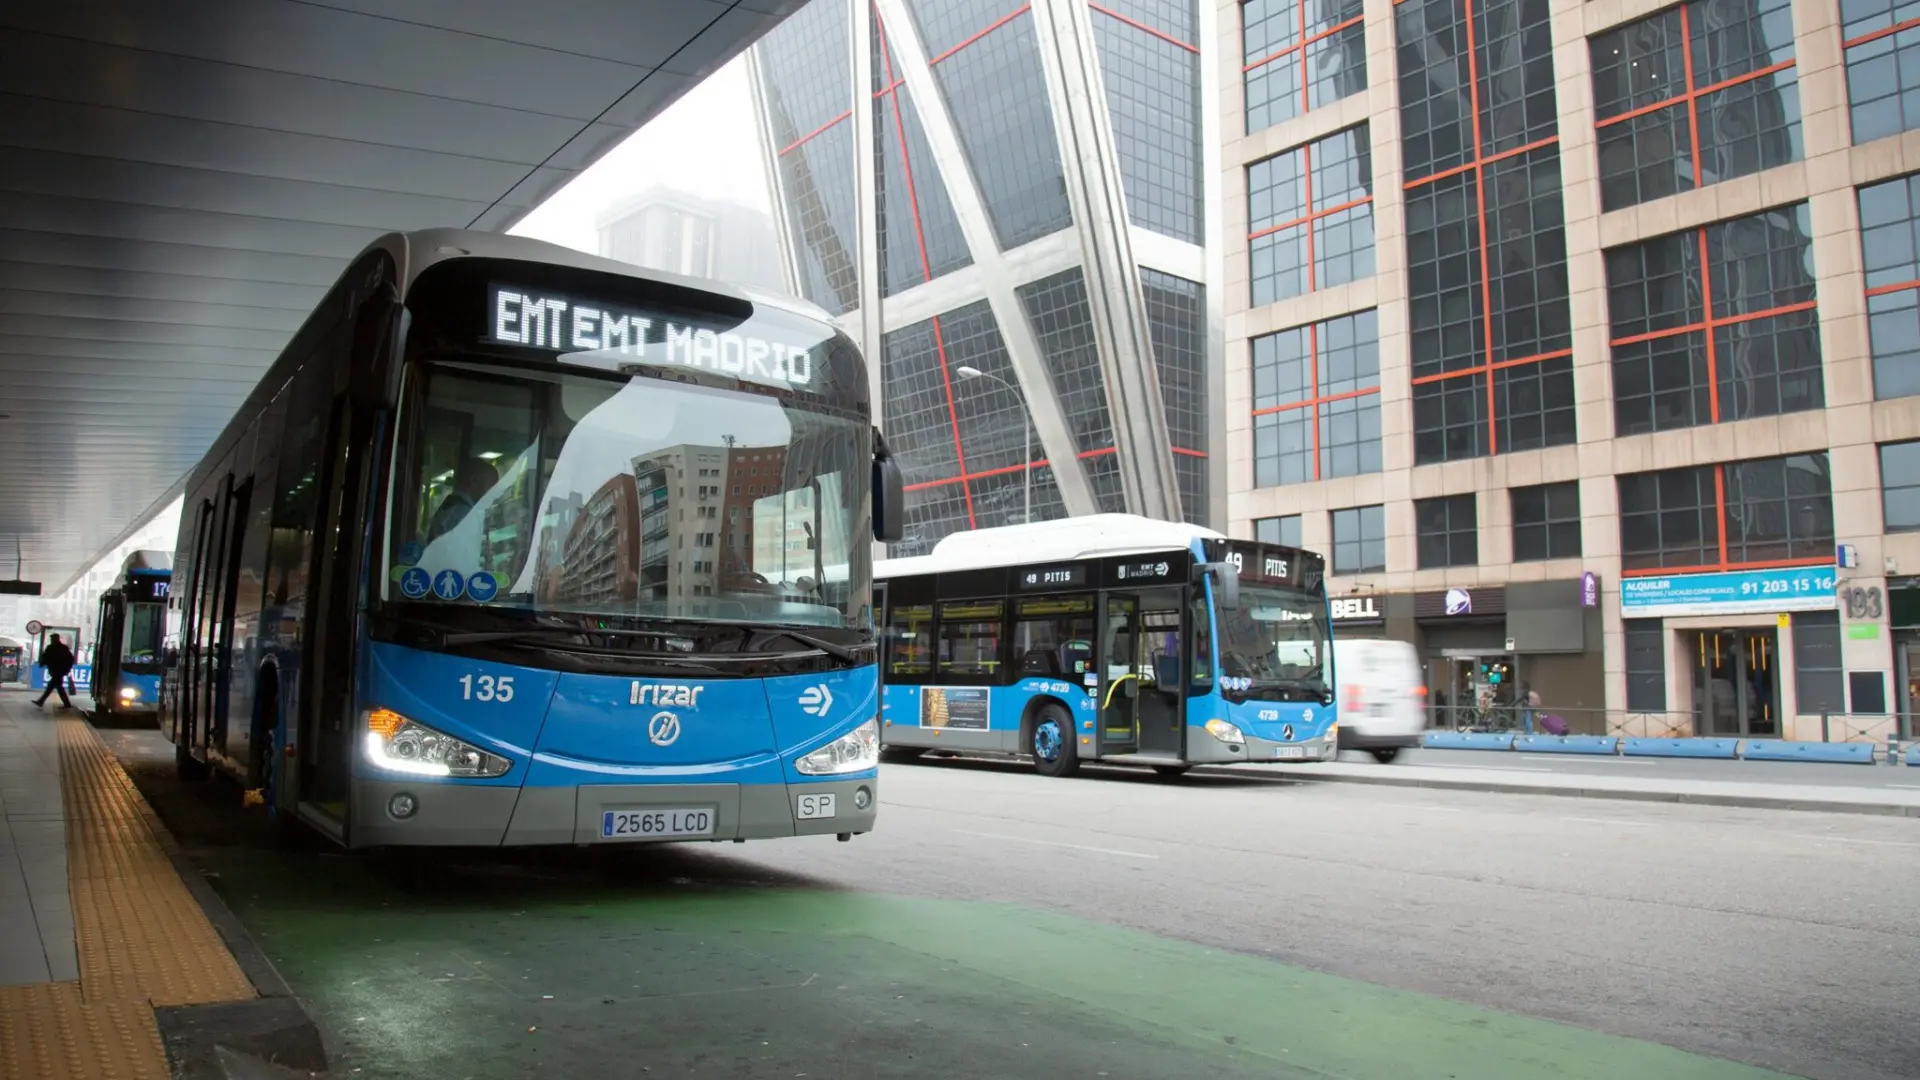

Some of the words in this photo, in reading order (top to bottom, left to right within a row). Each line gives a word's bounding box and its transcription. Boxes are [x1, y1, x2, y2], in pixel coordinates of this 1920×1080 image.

[496, 290, 567, 348] EMT
[572, 305, 652, 356] EMT
[666, 322, 811, 385] MADRID
[1225, 552, 1243, 574] 49
[1265, 558, 1288, 578] PITIS
[1026, 573, 1037, 584] 49
[1044, 571, 1071, 583] PITIS
[1626, 581, 1671, 591] ALQUILER
[1741, 582, 1758, 595] 91
[1762, 580, 1789, 593] 203
[1792, 578, 1810, 591] 15
[1814, 577, 1832, 590] 16
[1331, 598, 1379, 618] BELL
[1841, 586, 1882, 618] 193
[459, 674, 514, 702] 135
[630, 680, 704, 706] Irizar
[616, 813, 666, 833] 2565
[672, 812, 708, 832] LCD
